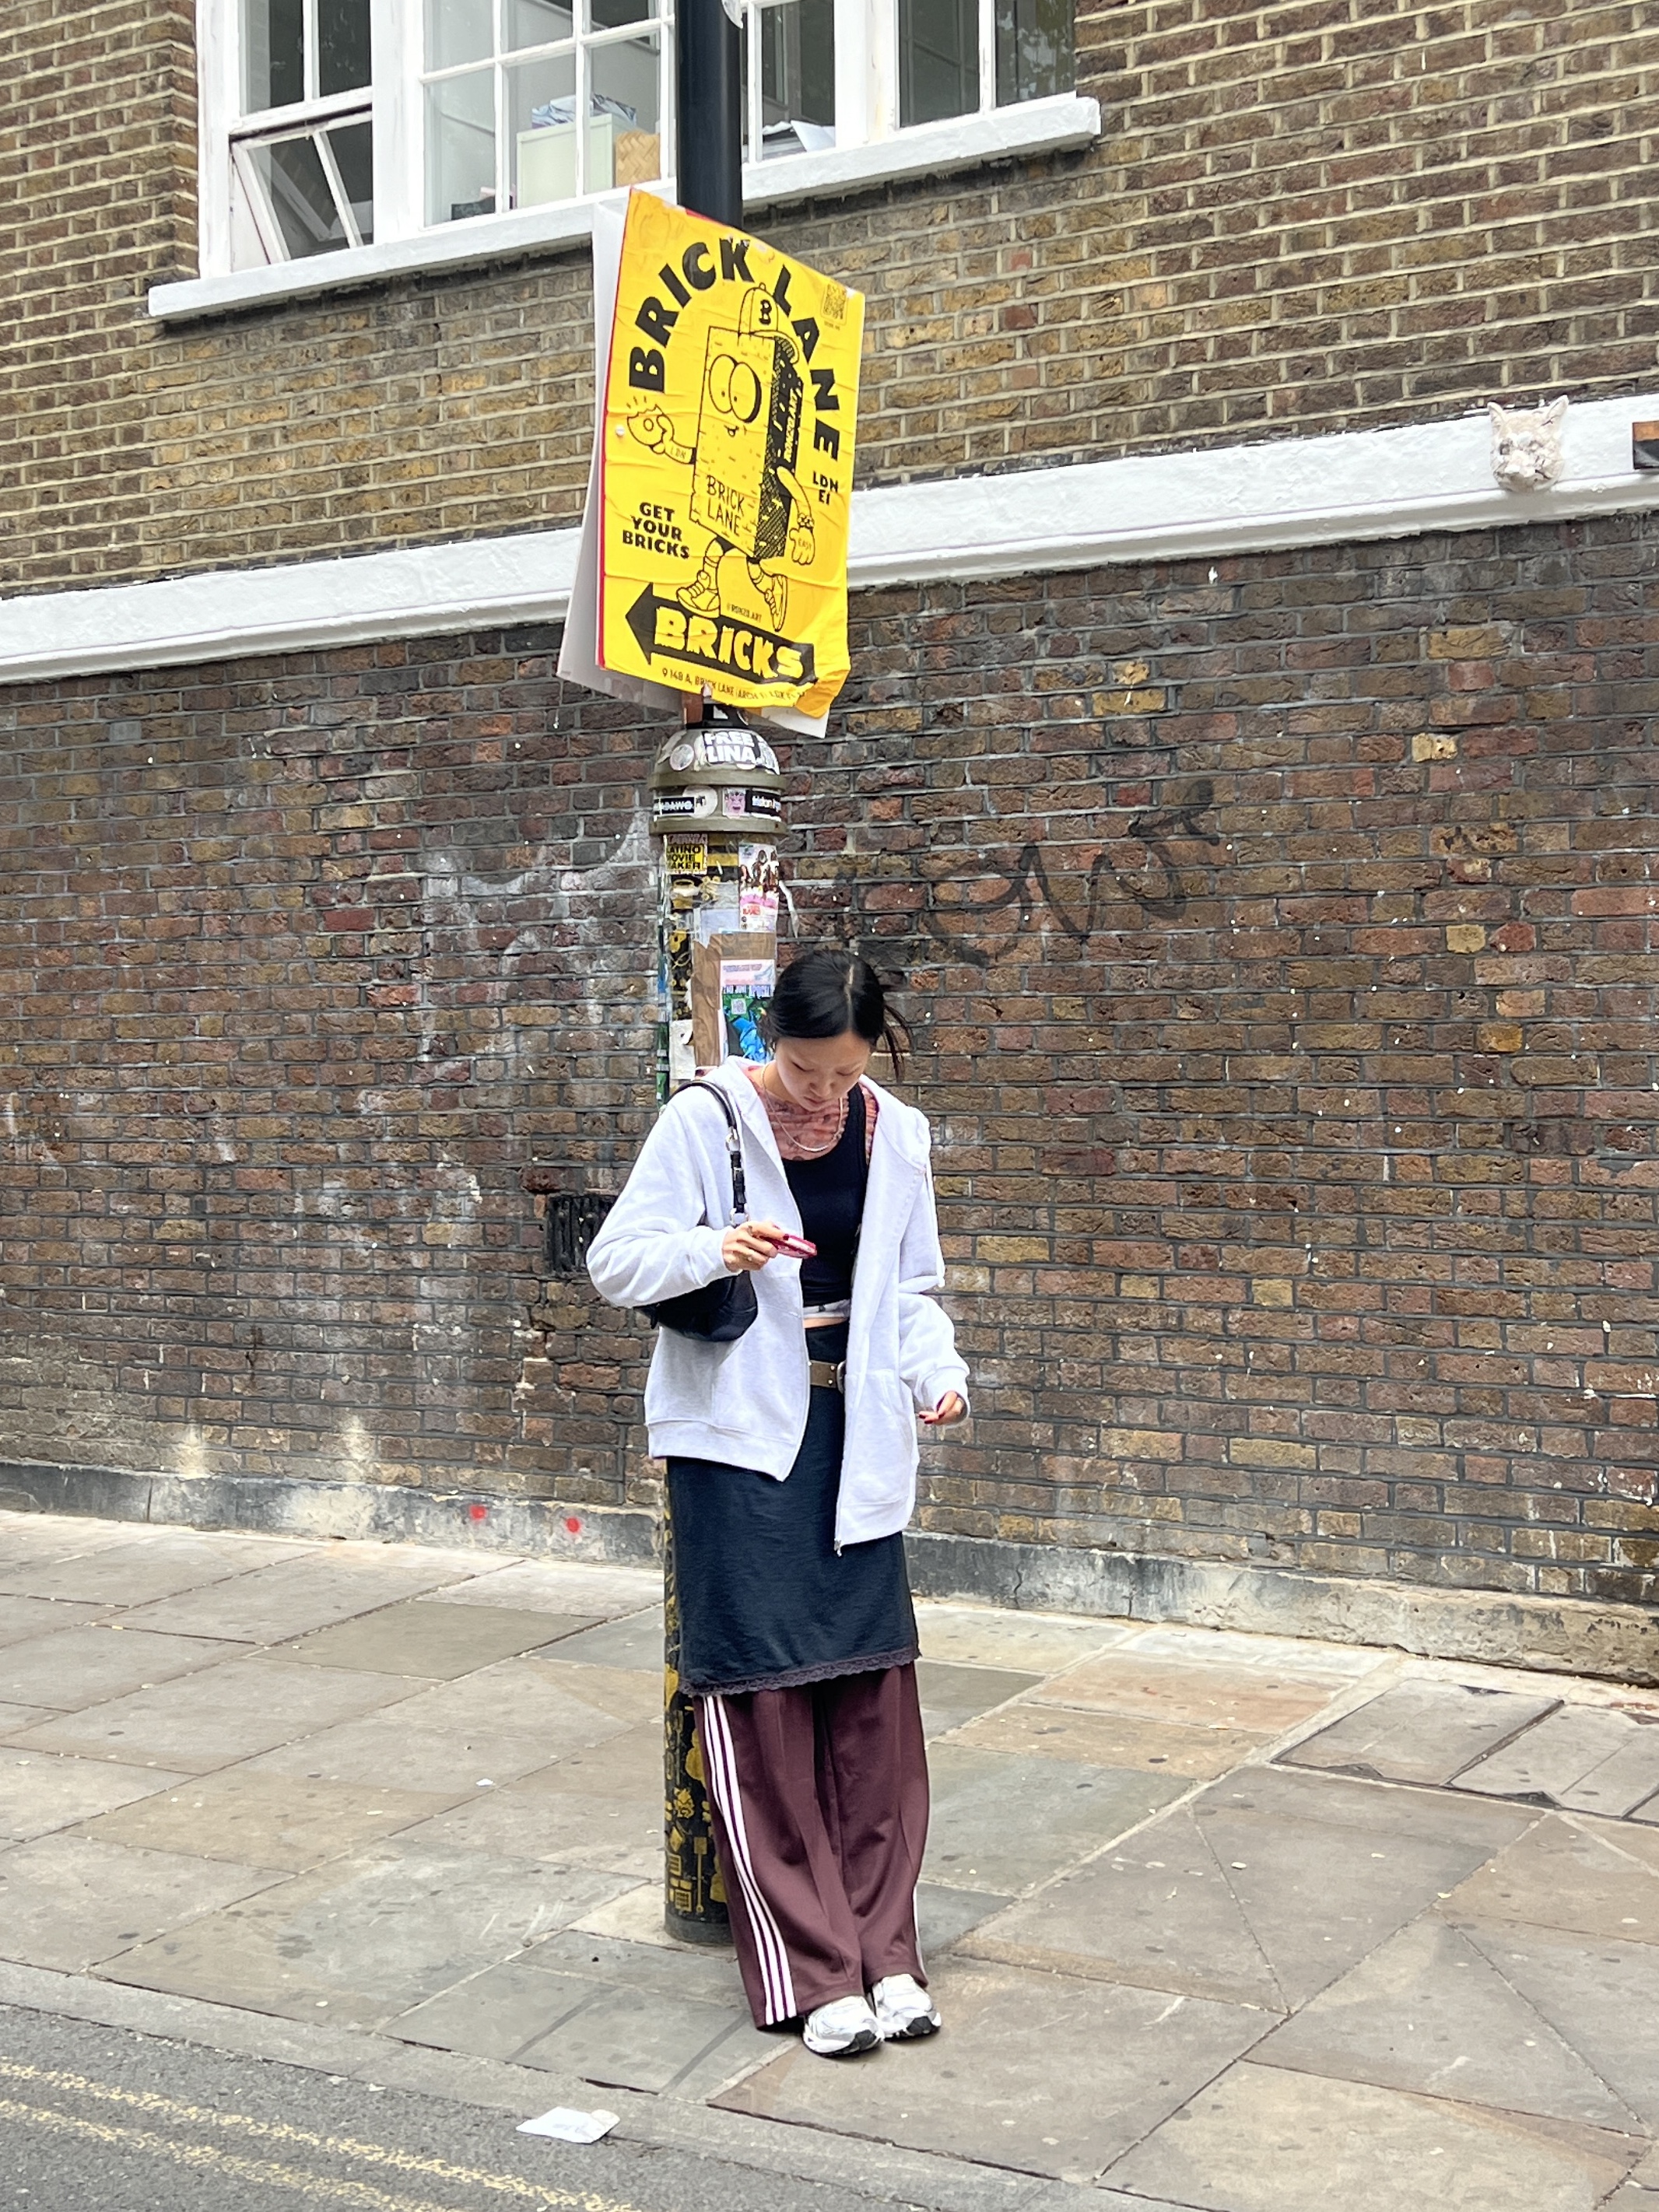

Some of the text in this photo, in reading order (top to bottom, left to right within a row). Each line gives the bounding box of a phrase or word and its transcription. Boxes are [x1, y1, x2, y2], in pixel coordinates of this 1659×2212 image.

[629, 237, 840, 461] BRICK LANE
[707, 475, 745, 517] BRICK
[813, 471, 839, 493] LDN
[640, 502, 675, 523] GET
[707, 498, 742, 537] LANE
[631, 515, 682, 542] YOUR
[622, 530, 689, 560] BRICKS
[654, 606, 803, 680] BRICKS
[703, 731, 755, 747] FREE
[707, 745, 757, 765] LINA
